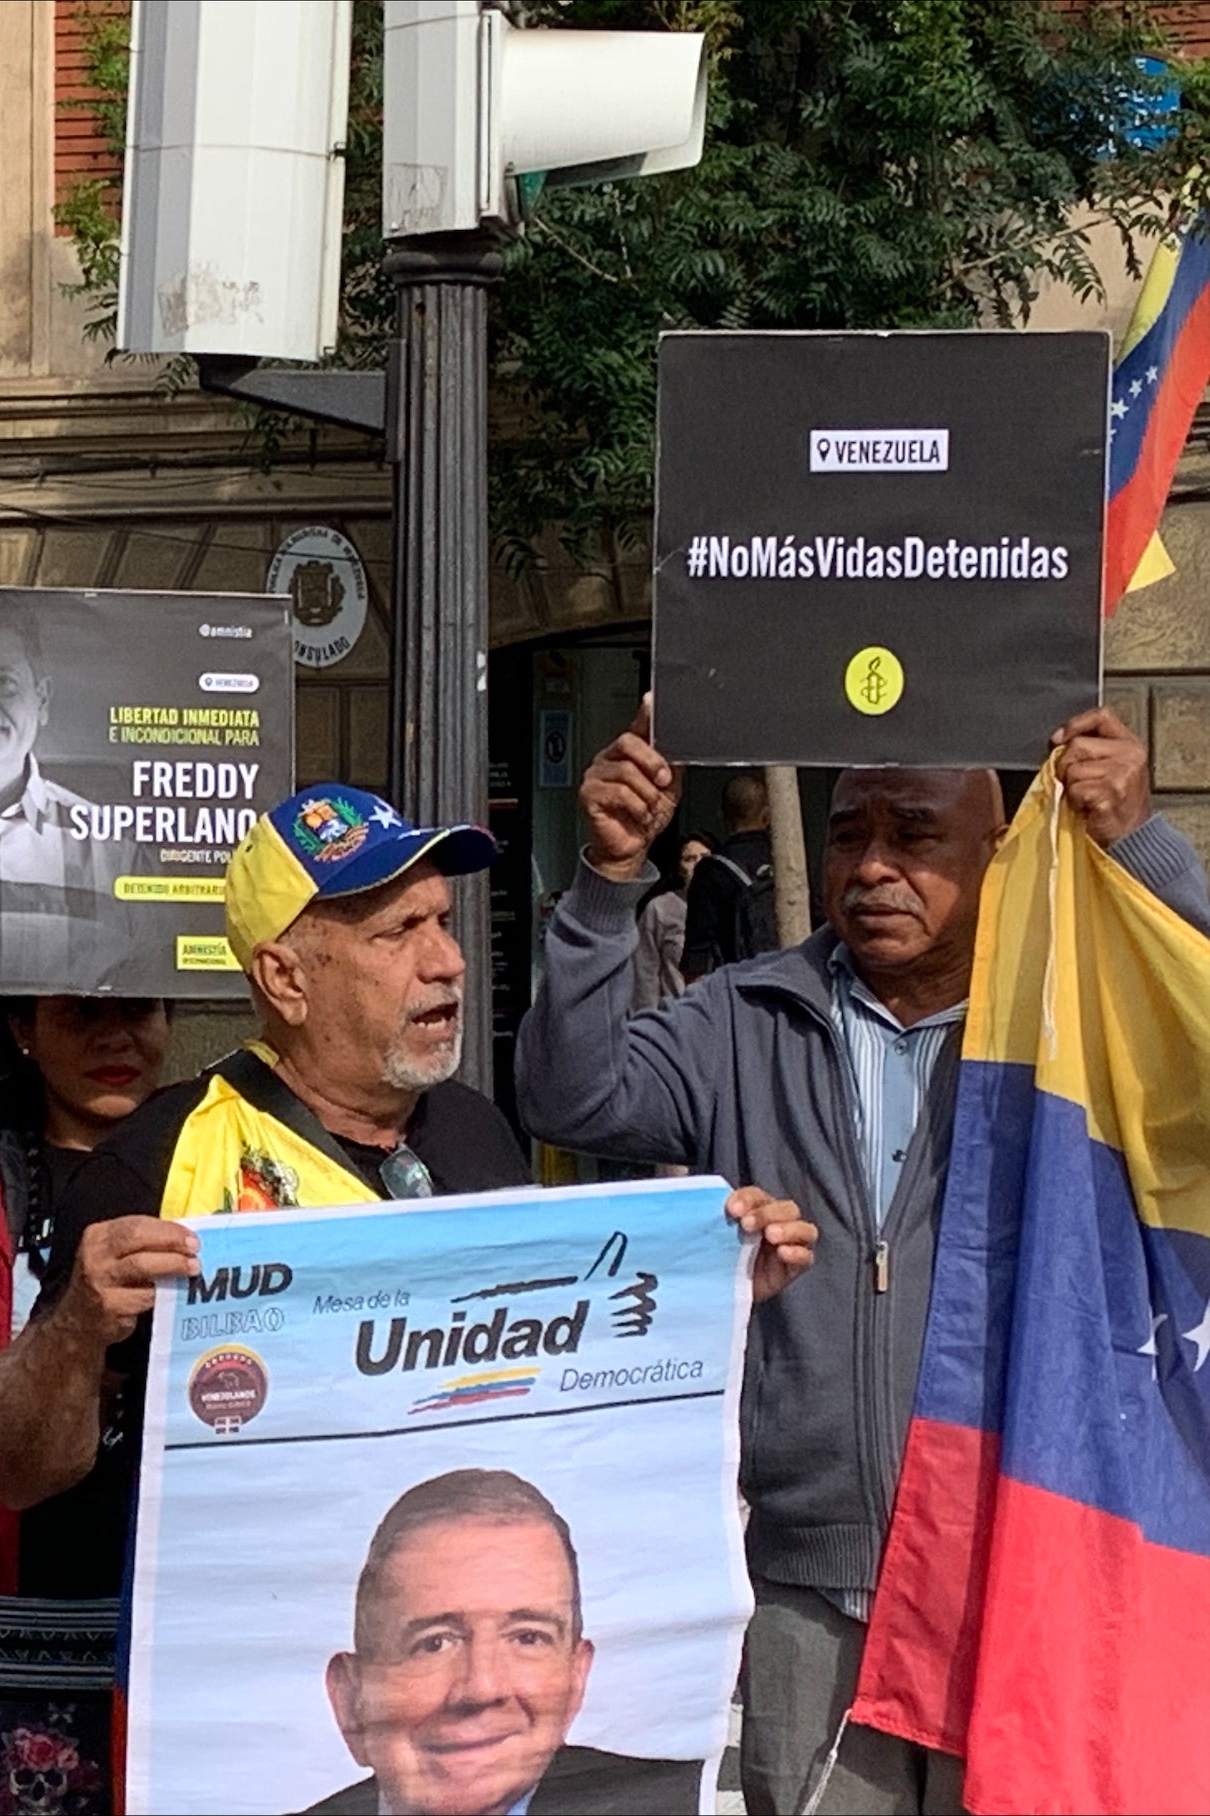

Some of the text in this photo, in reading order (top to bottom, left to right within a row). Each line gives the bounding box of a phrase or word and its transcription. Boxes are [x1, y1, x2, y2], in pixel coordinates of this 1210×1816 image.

[835, 440, 940, 464] VENEZUELA
[687, 535, 1069, 579] #NoMásVidasDetenidas
[109, 707, 260, 728] LIBERTAD INMEDIATA
[109, 727, 260, 746] E INCONDICIONAL PARA
[132, 760, 260, 800] FREDDY
[160, 848, 212, 864] DIRIGENTE
[123, 882, 170, 894] DETENIDO
[186, 1263, 293, 1305] MUD
[313, 1289, 411, 1315] Mesa de la
[181, 1307, 285, 1341] BILBAO
[355, 1299, 590, 1377] Unidad
[559, 1358, 703, 1392] Democrática
